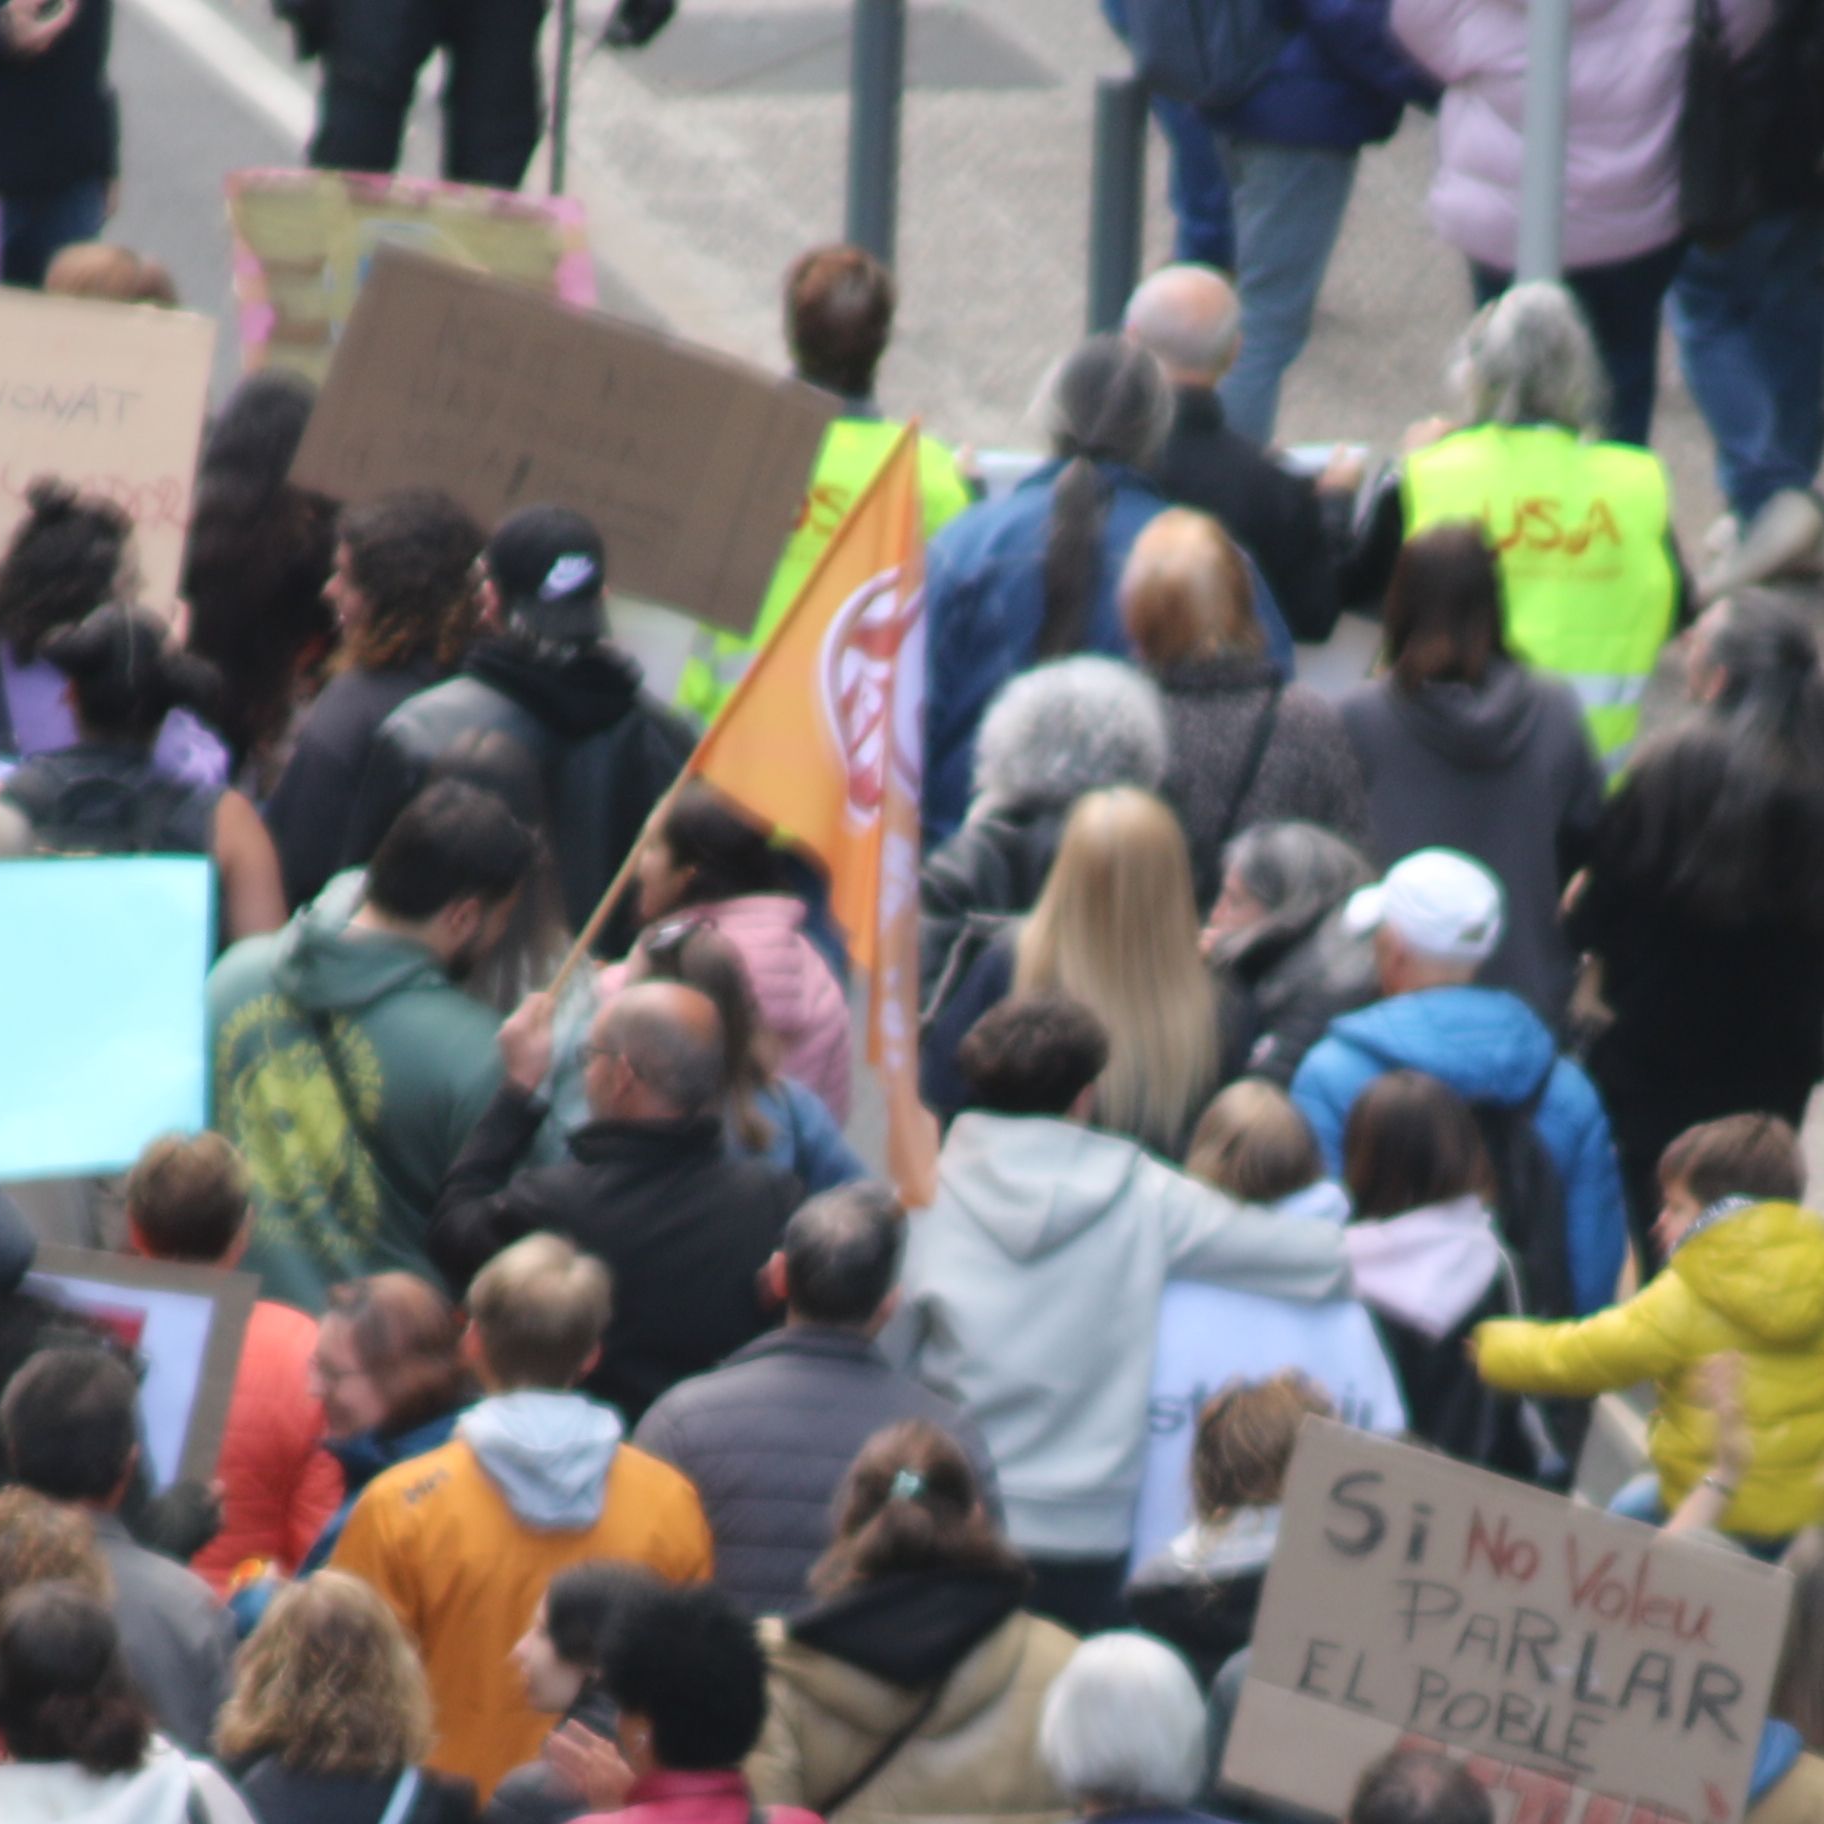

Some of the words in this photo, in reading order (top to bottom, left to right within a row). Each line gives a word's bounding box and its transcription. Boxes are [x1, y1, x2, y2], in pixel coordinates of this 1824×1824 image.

[1323, 1469, 1437, 1564] Si
[1465, 1505, 1542, 1583] No
[1562, 1529, 1718, 1646] Voleu
[1295, 1637, 1392, 1712] EL
[1402, 1664, 1609, 1776] POBLE
[1393, 1578, 1743, 1746] PARLAR
